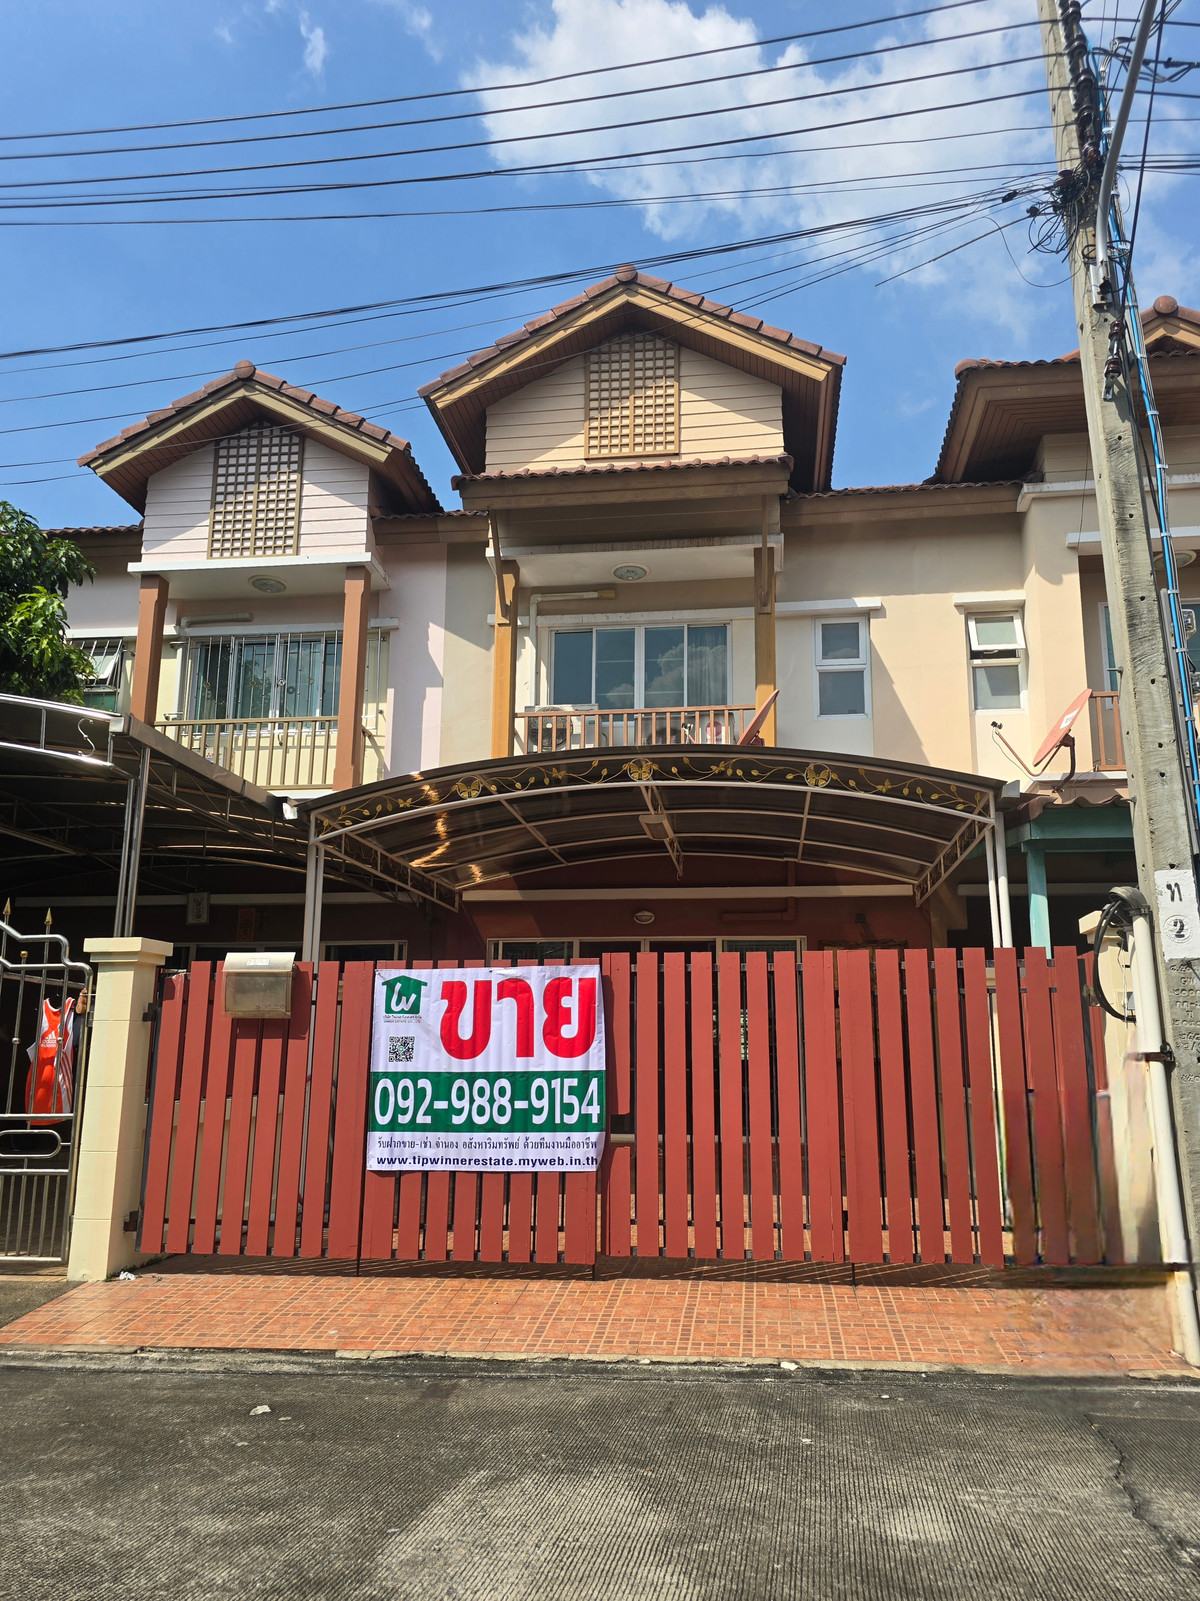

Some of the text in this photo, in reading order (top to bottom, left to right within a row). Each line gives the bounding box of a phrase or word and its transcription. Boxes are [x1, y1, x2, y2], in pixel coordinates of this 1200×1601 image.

[440, 976, 597, 1060] ขาย
[374, 1077, 601, 1126] 092-988-9154
[377, 1136, 597, 1150] รับฝากขาย-เช่า จำนอง อสังหาริมทรัพย์ ด้วยทีมงานมืออาชีพ
[376, 1155, 598, 1168] www.tipwinnerestate.myweb.in.th
